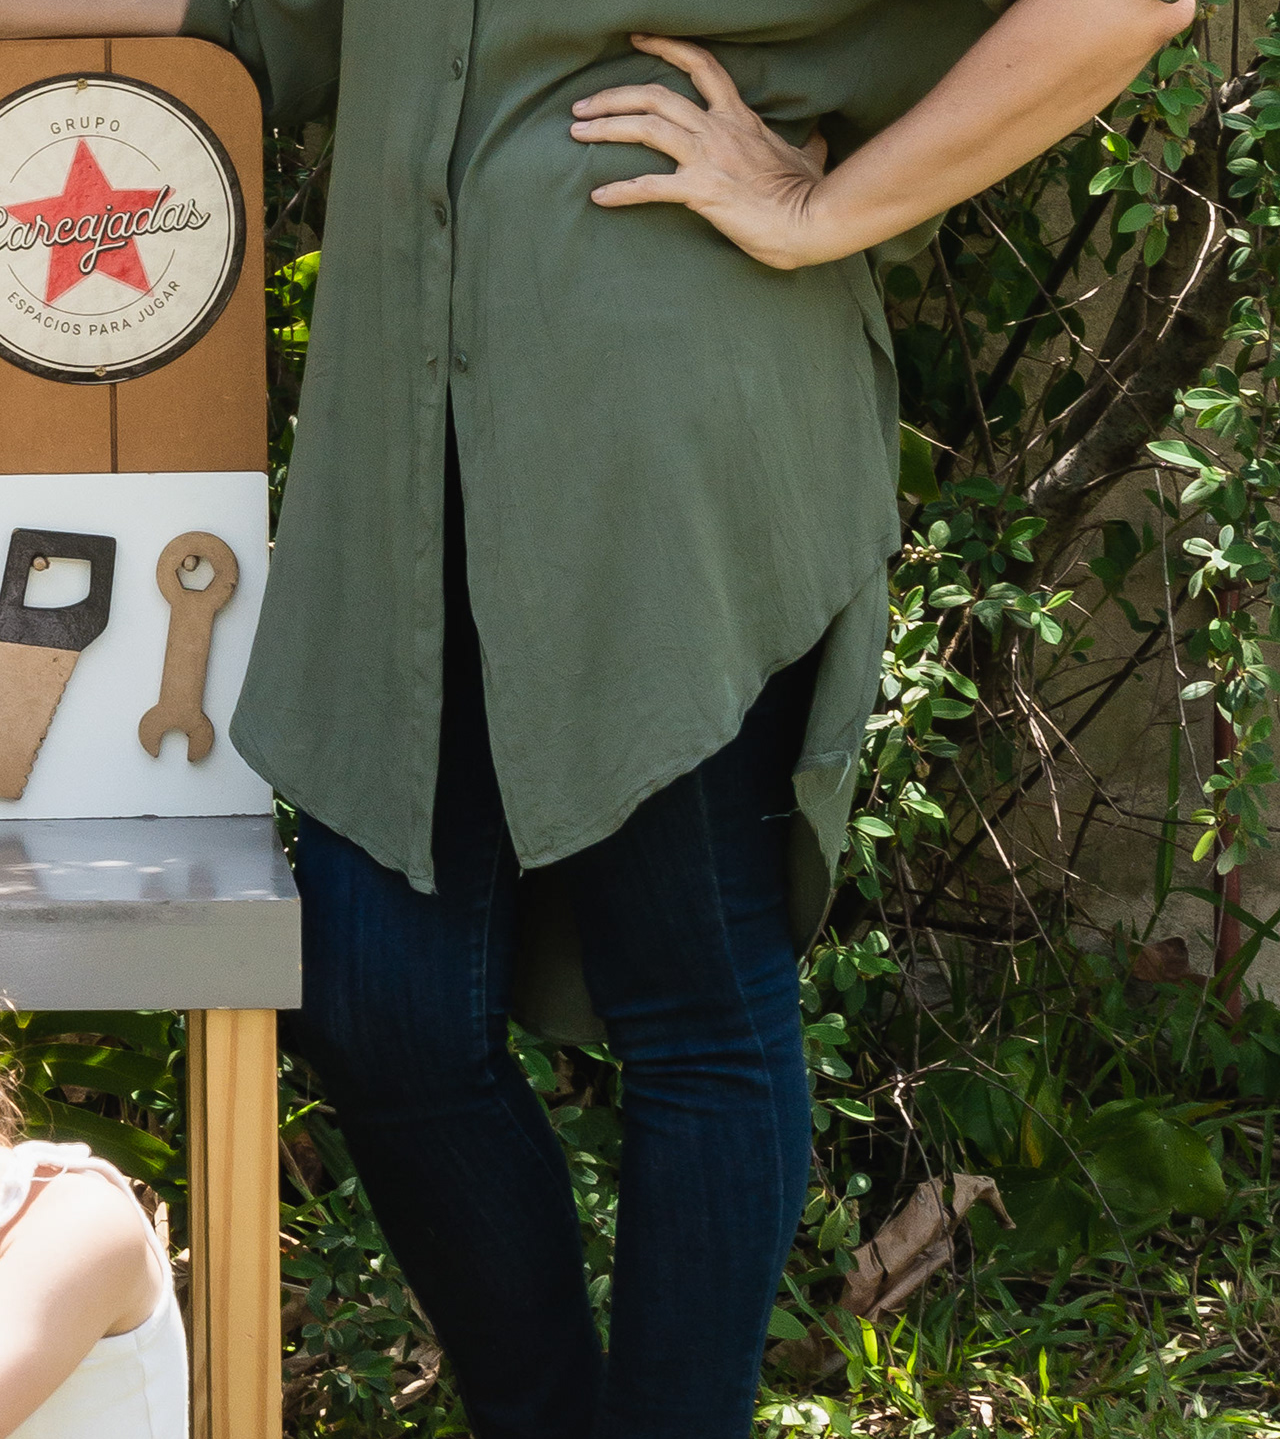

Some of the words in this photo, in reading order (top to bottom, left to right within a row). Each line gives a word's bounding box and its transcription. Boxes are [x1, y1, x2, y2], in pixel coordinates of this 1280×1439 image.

[50, 116, 121, 136] GRUPO
[7, 291, 82, 336] ESPACIOS
[88, 320, 132, 336] PARA
[138, 279, 182, 324] JUGAR
